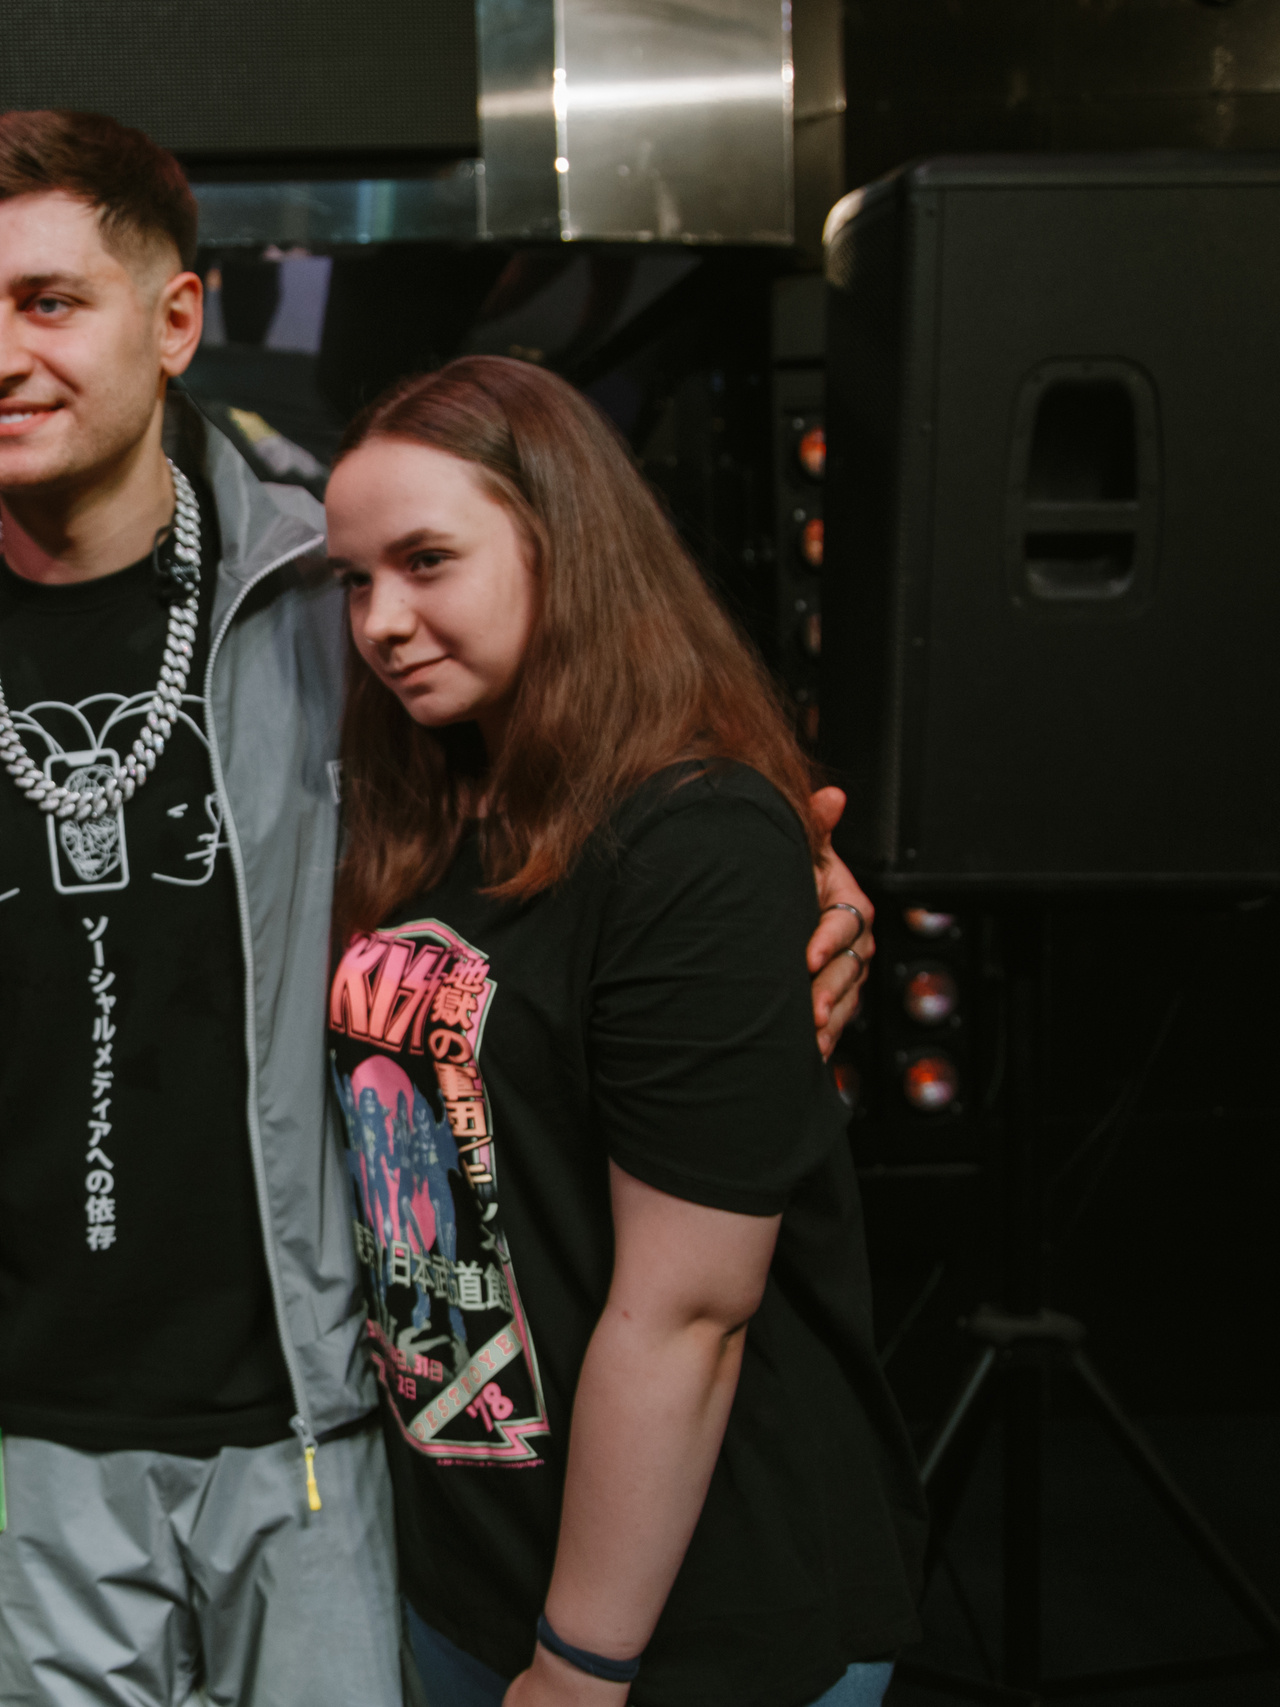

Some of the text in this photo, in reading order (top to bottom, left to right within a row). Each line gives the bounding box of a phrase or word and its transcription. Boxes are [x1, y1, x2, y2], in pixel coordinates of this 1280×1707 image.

[82, 916, 117, 1251] ソーシャルメディアへの依存
[465, 1381, 515, 1433] '78
